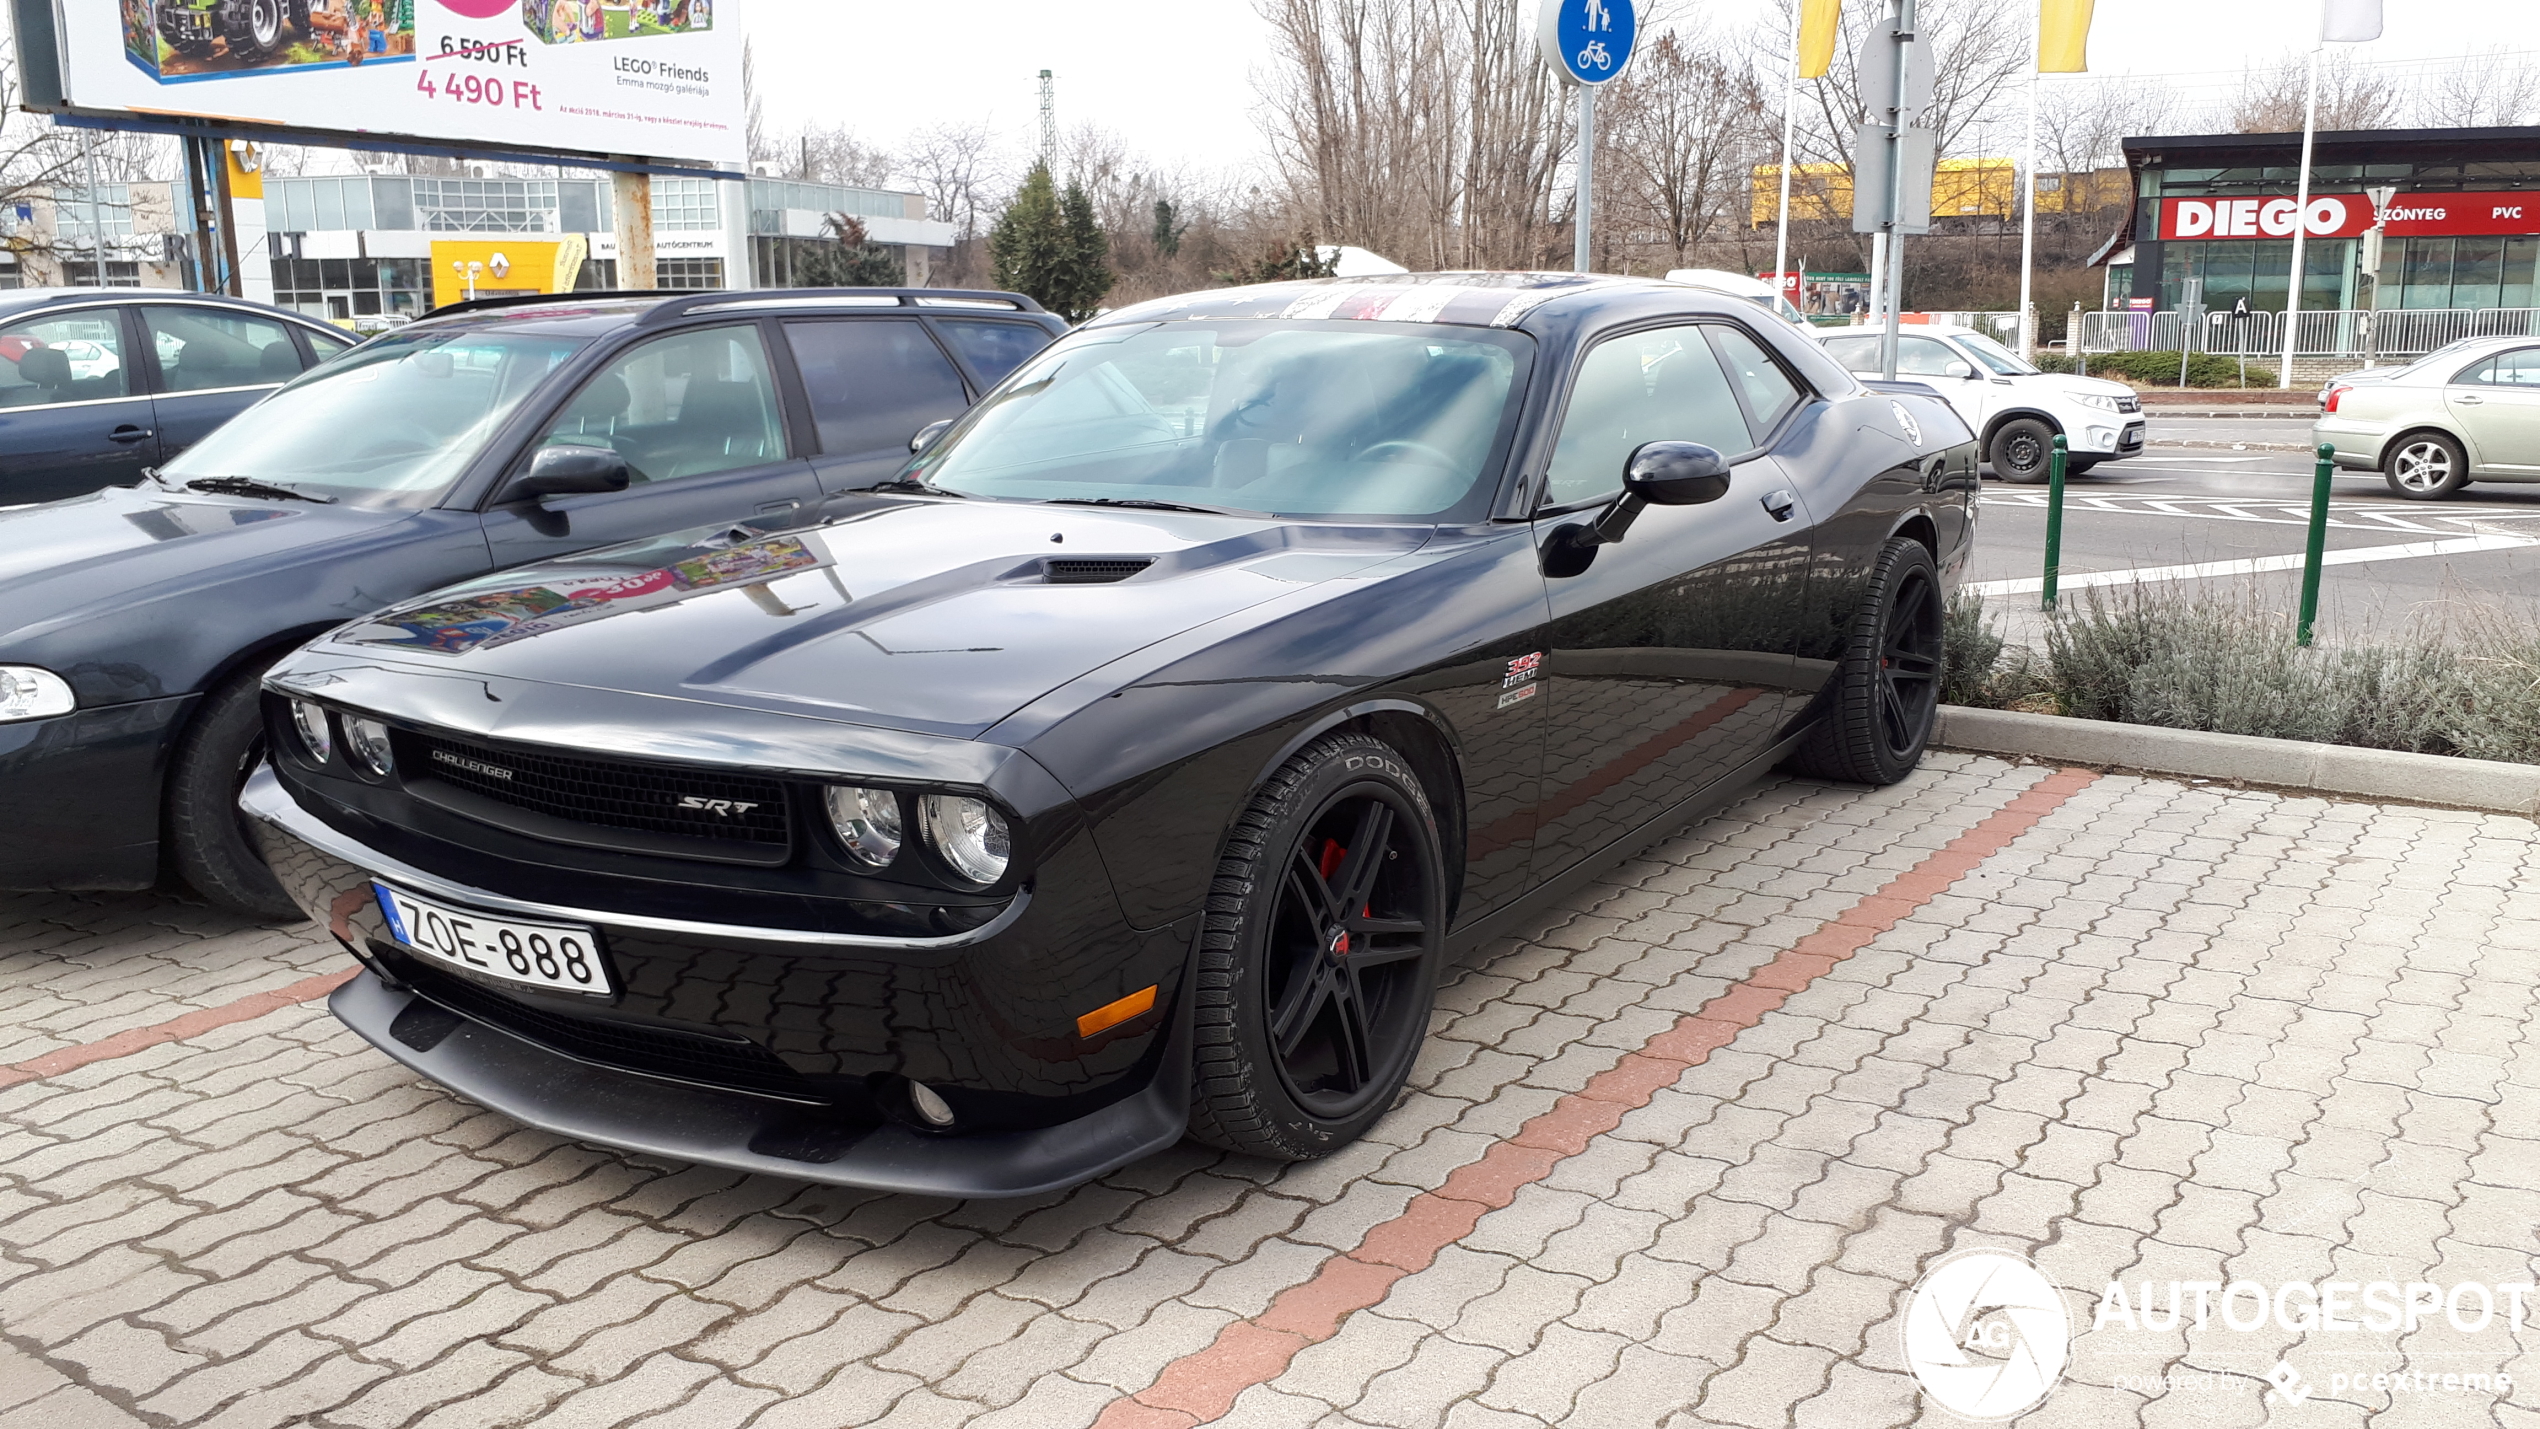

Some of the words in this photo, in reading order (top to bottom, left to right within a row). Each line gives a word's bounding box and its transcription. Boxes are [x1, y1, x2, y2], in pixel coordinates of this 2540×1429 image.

[440, 35, 454, 57] 6
[460, 38, 500, 63] 590
[506, 44, 528, 67] Ft
[660, 62, 709, 82] Friends
[417, 69, 436, 99] 4
[445, 72, 504, 106] 490
[513, 80, 542, 111] Ft
[616, 76, 644, 88] Emma
[646, 80, 674, 94] mozgó
[676, 84, 710, 98] galériája
[603, 110, 626, 120] március
[2174, 198, 2346, 237] DIEGO
[2492, 206, 2522, 220] PVC
[1506, 652, 1542, 677] 392
[1502, 667, 1538, 688] HEMI
[432, 750, 512, 781] CHALLENGER
[1345, 756, 1428, 817] DODGE
[678, 796, 758, 817] SRT
[392, 919, 404, 936] H
[399, 900, 592, 984] ZOE-888
